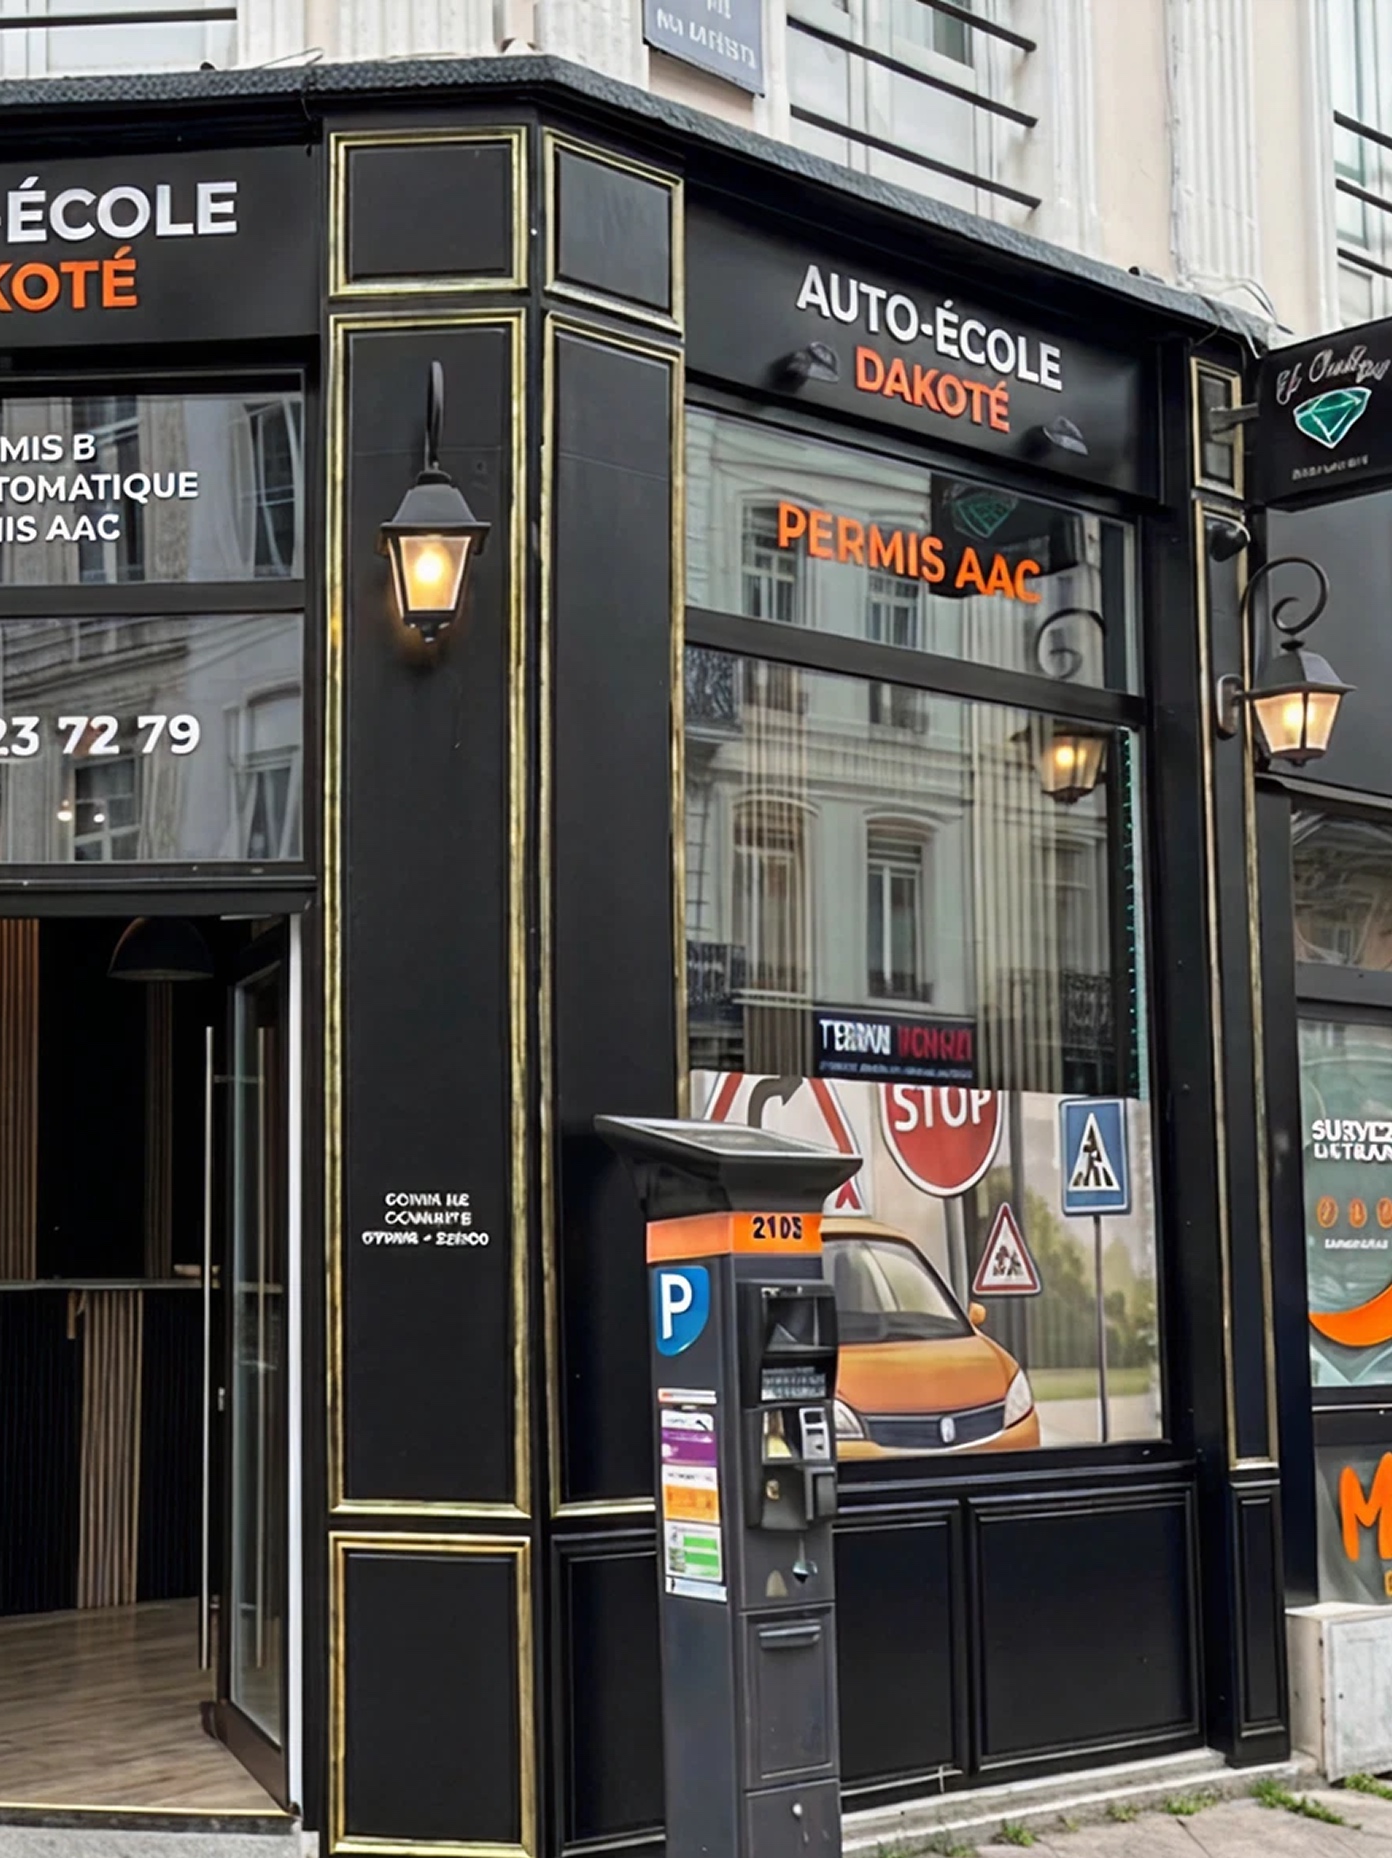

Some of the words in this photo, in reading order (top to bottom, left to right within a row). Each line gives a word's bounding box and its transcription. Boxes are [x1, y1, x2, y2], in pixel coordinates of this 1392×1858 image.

[796, 264, 1063, 392] AUTO-ÉCOLE
[855, 346, 1011, 433] DAKOTÉ
[73, 434, 96, 461] B
[46, 513, 120, 541] AAC
[777, 500, 946, 584] PERMIS
[954, 545, 1043, 605] AAC
[57, 716, 120, 756] 72
[137, 714, 201, 755] 79
[892, 1084, 992, 1132] STOP
[660, 1273, 693, 1340] P
